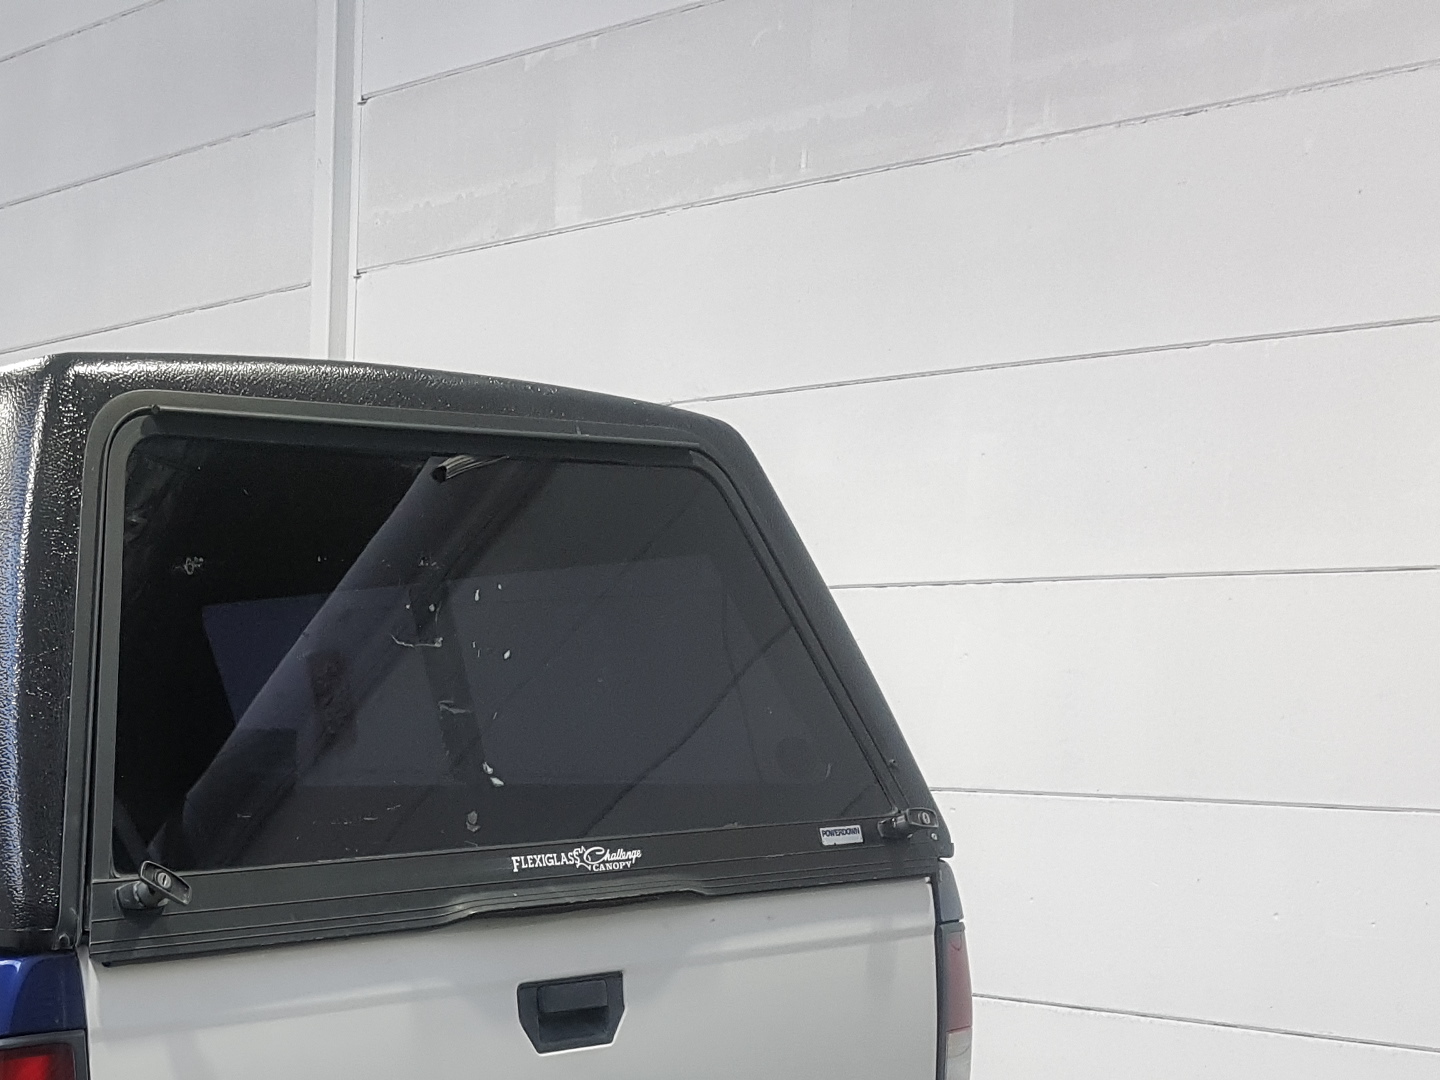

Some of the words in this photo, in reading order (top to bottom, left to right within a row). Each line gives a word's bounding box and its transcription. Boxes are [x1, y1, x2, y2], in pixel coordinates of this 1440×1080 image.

[821, 826, 860, 837] POWERDOWN
[511, 848, 582, 873] FLEXIGLASS
[583, 846, 642, 865] Challenge
[592, 860, 632, 872] CANOPY
